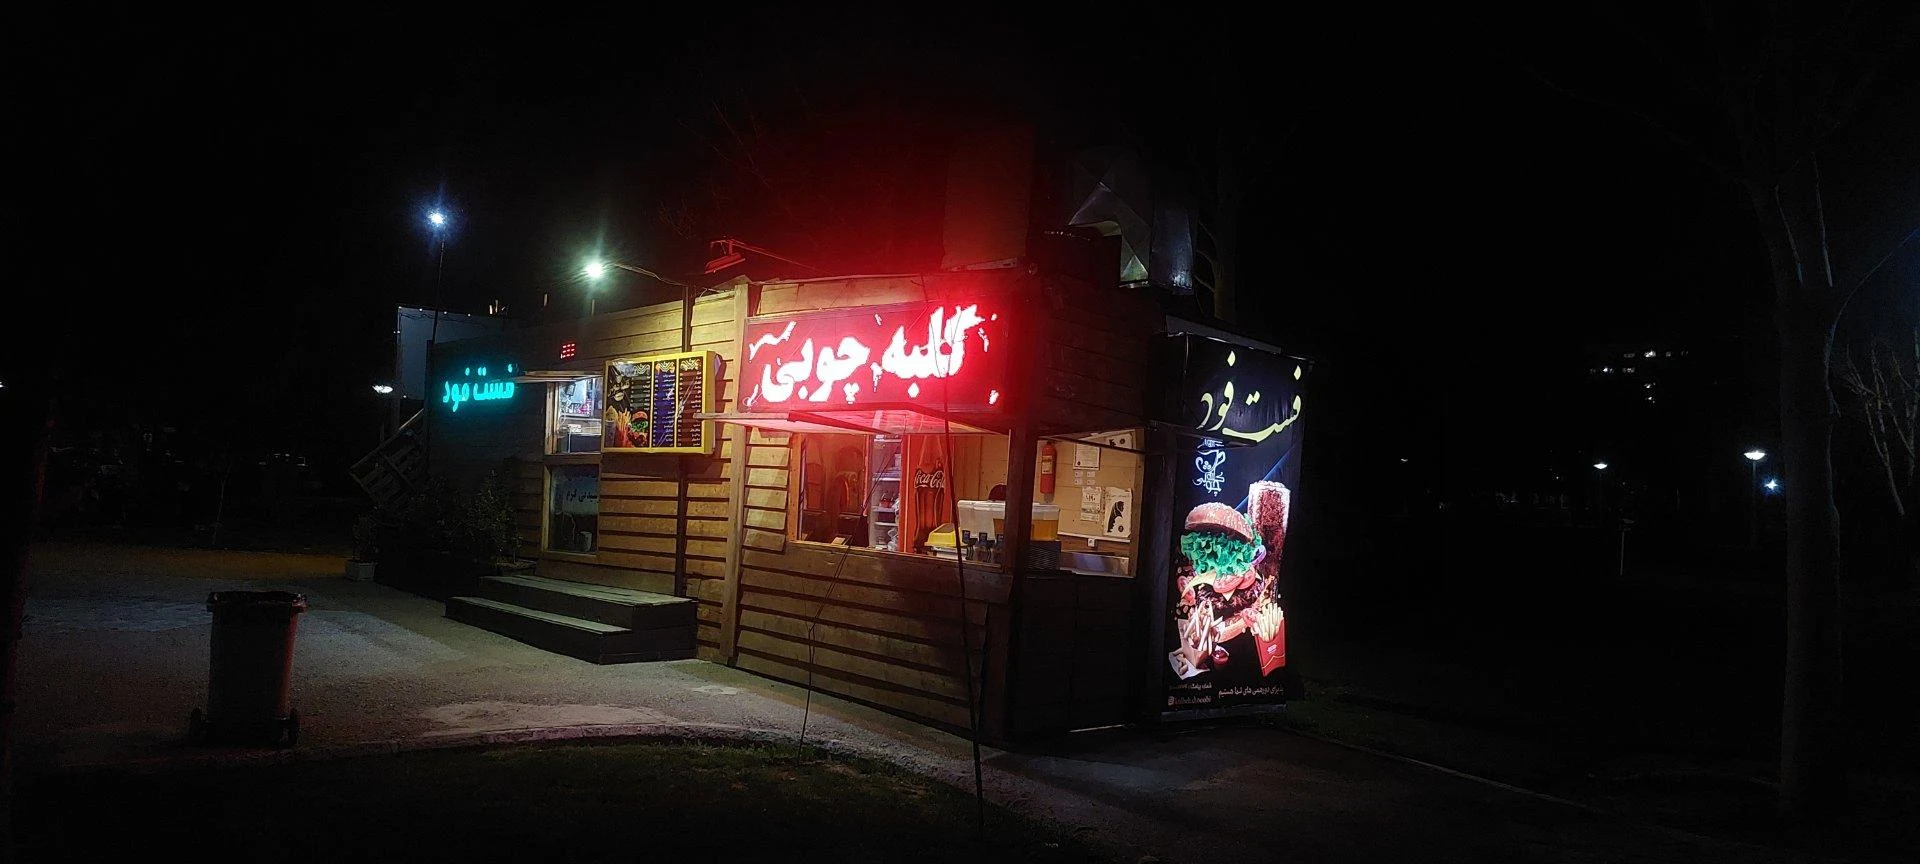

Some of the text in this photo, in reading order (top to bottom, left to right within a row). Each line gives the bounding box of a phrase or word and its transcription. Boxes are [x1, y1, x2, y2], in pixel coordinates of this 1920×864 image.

[442, 363, 515, 412] فست فود
[761, 304, 986, 404] کلبه چوبی
[1196, 350, 1303, 444] فست فود
[1218, 688, 1234, 699] هستیم
